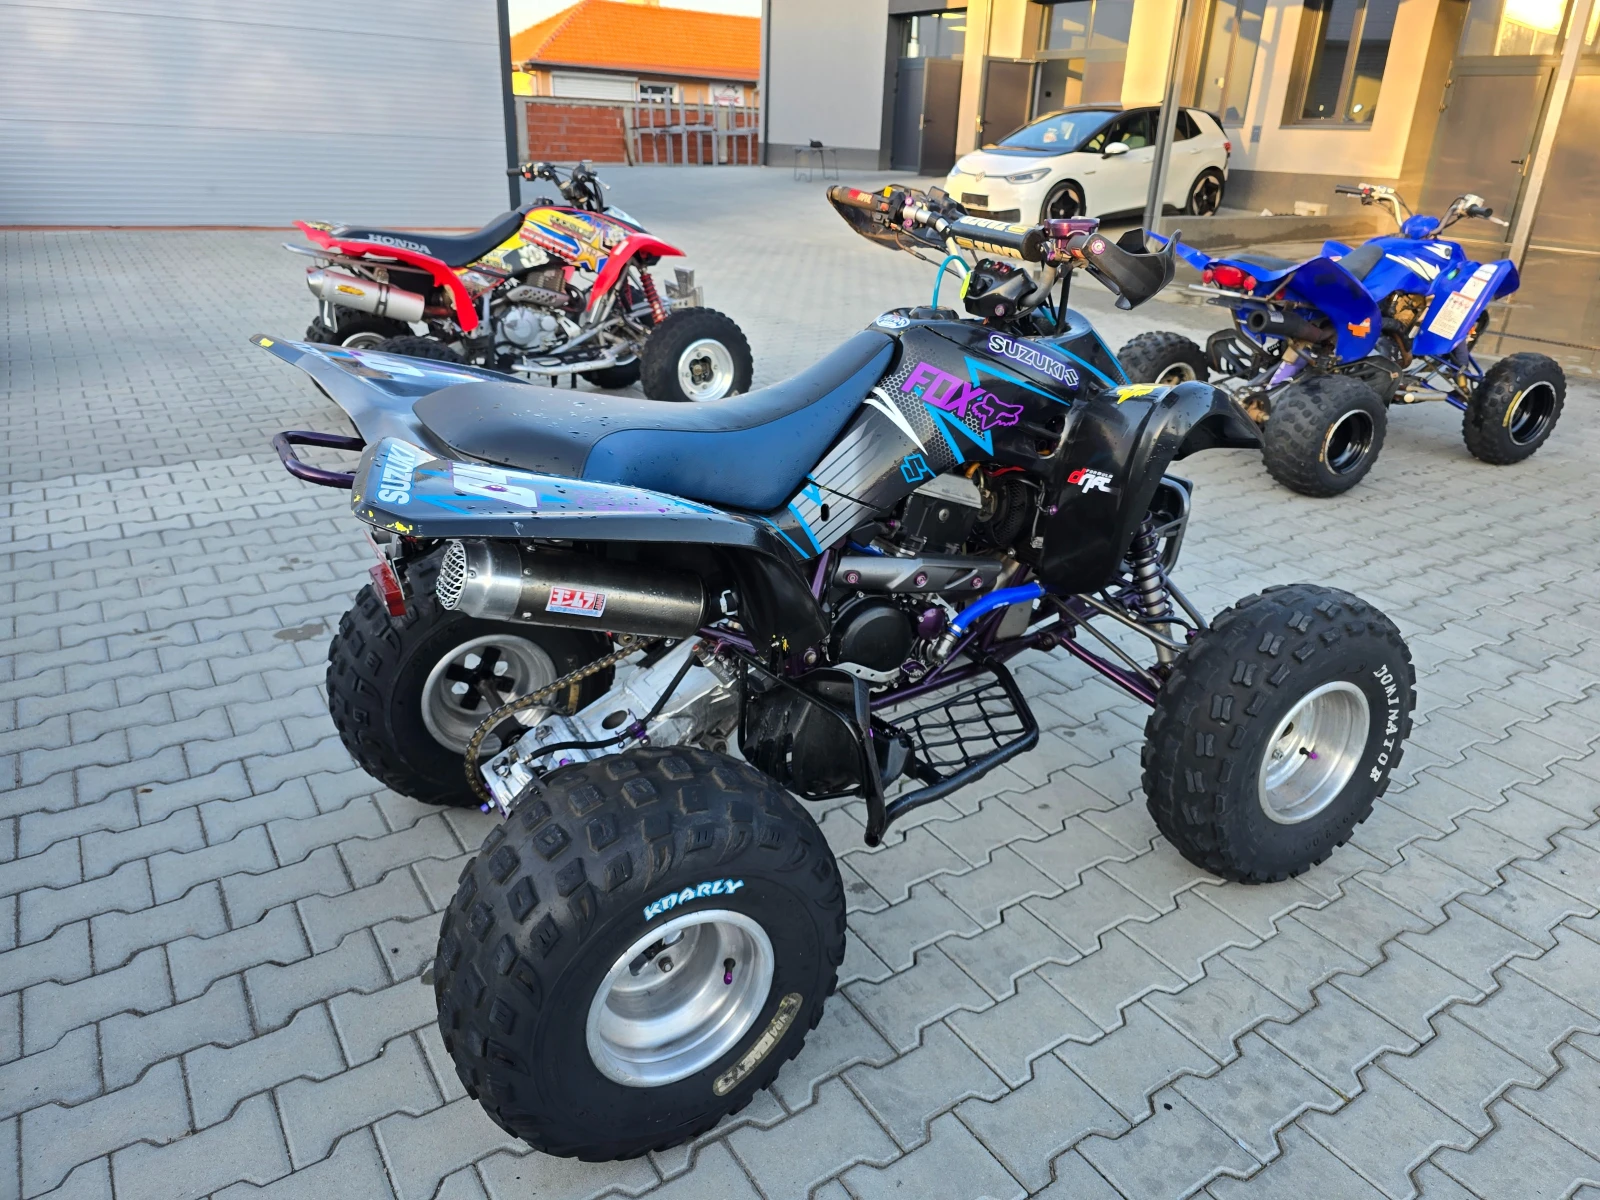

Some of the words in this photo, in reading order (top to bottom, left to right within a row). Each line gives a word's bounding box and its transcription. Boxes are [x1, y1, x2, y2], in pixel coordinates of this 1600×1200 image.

[368, 233, 432, 255] HONDA
[989, 335, 1066, 381] SUZUKI
[901, 361, 987, 418] FOX
[378, 443, 416, 505] SUZUKI
[1372, 664, 1399, 783] DOMINATOR
[643, 879, 744, 921] KNARLY
